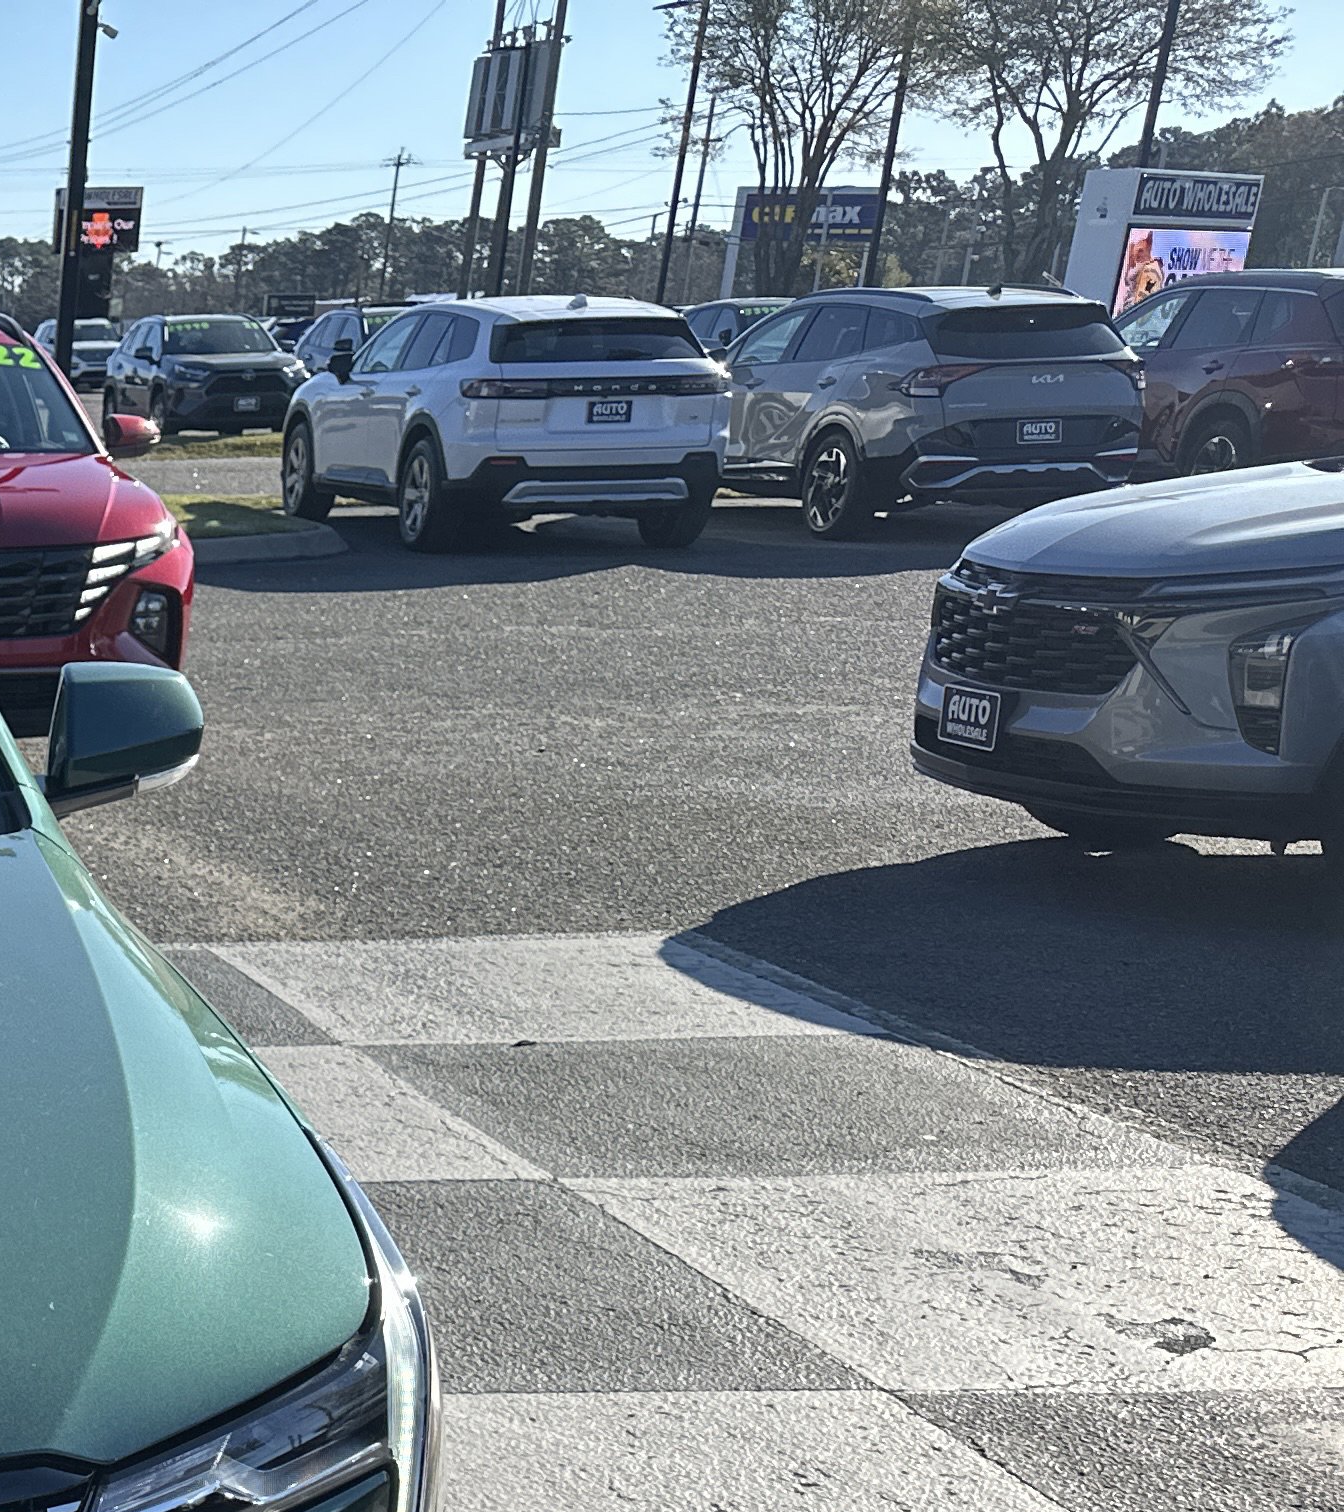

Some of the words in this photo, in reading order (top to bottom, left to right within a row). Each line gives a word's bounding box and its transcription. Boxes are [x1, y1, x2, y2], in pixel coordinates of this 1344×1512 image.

[1140, 180, 1180, 211] AUTO
[1182, 179, 1258, 214] WHOLESALE
[1168, 248, 1201, 270] SHOW
[593, 402, 627, 415] AUTO
[1023, 422, 1055, 434] AUTO
[948, 695, 991, 725] AUTO
[946, 721, 988, 741] WHOLESALE
